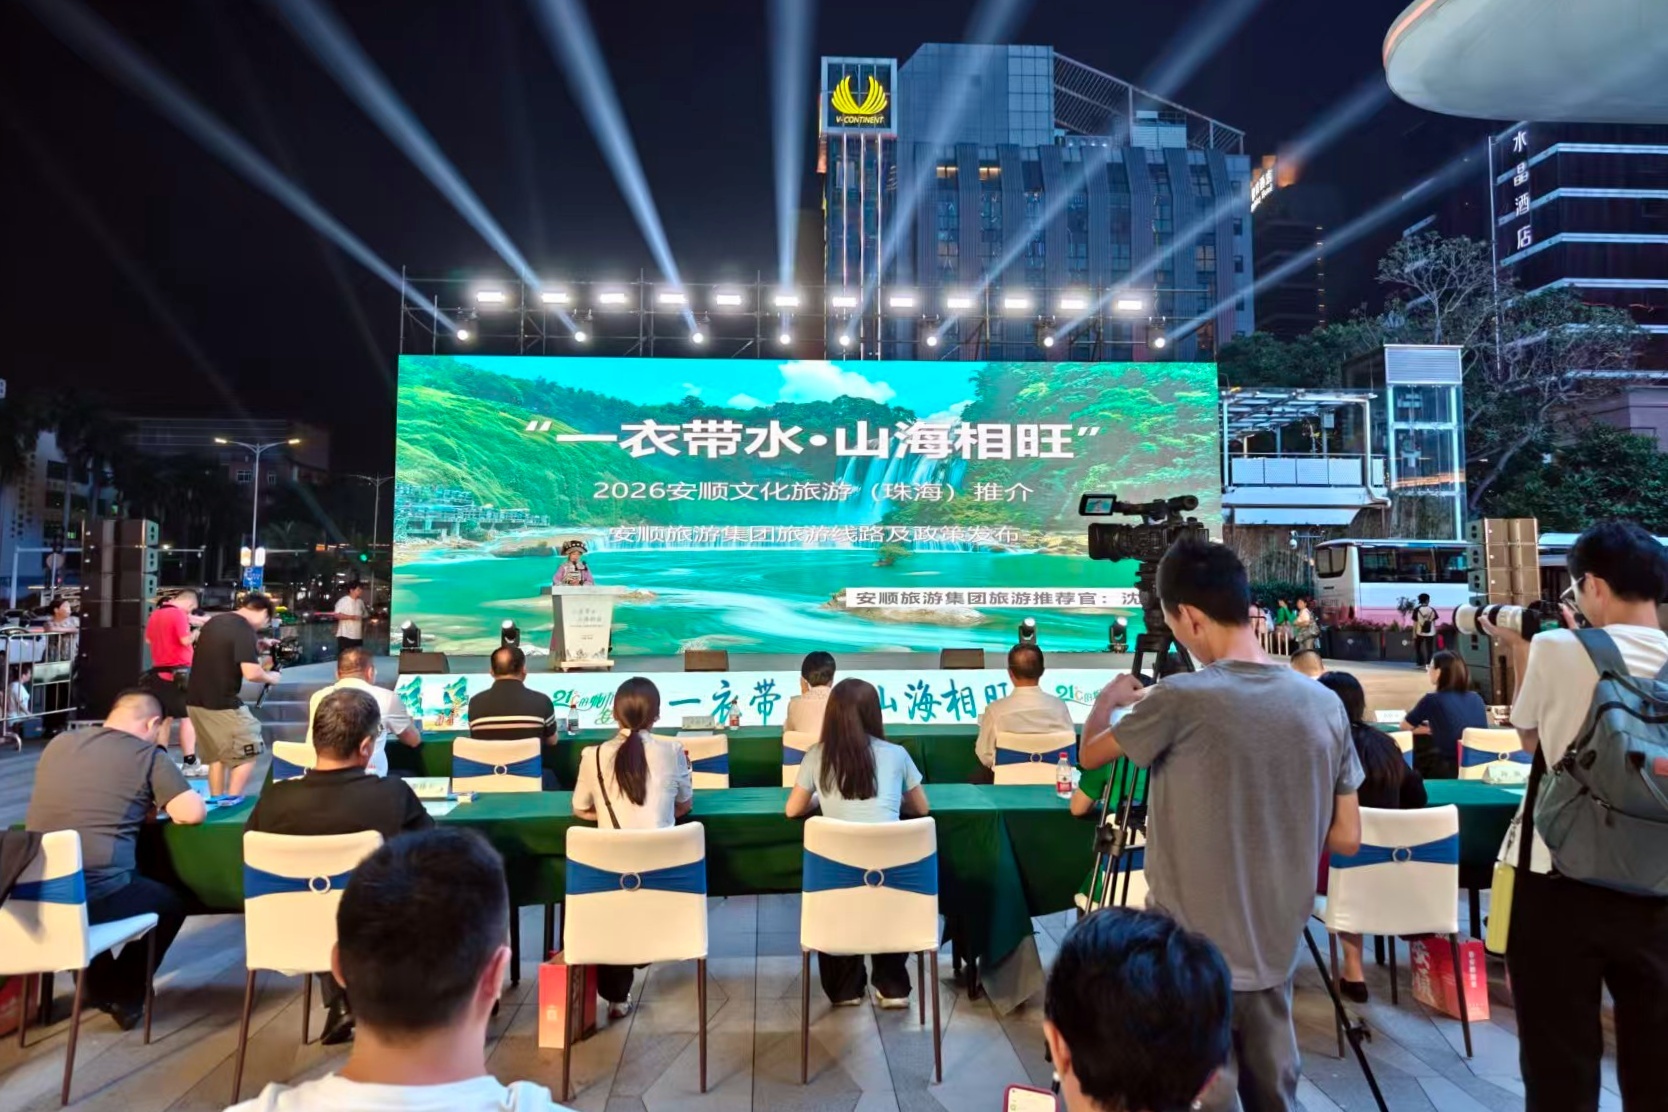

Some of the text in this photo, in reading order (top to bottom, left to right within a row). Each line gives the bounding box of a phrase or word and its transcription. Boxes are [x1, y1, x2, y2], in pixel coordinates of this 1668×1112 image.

[836, 115, 884, 124] V-CONTINENT
[1513, 130, 1532, 250] 水晶酒店
[609, 525, 1020, 544] 安顺旅游集团旅游线路及政策发布
